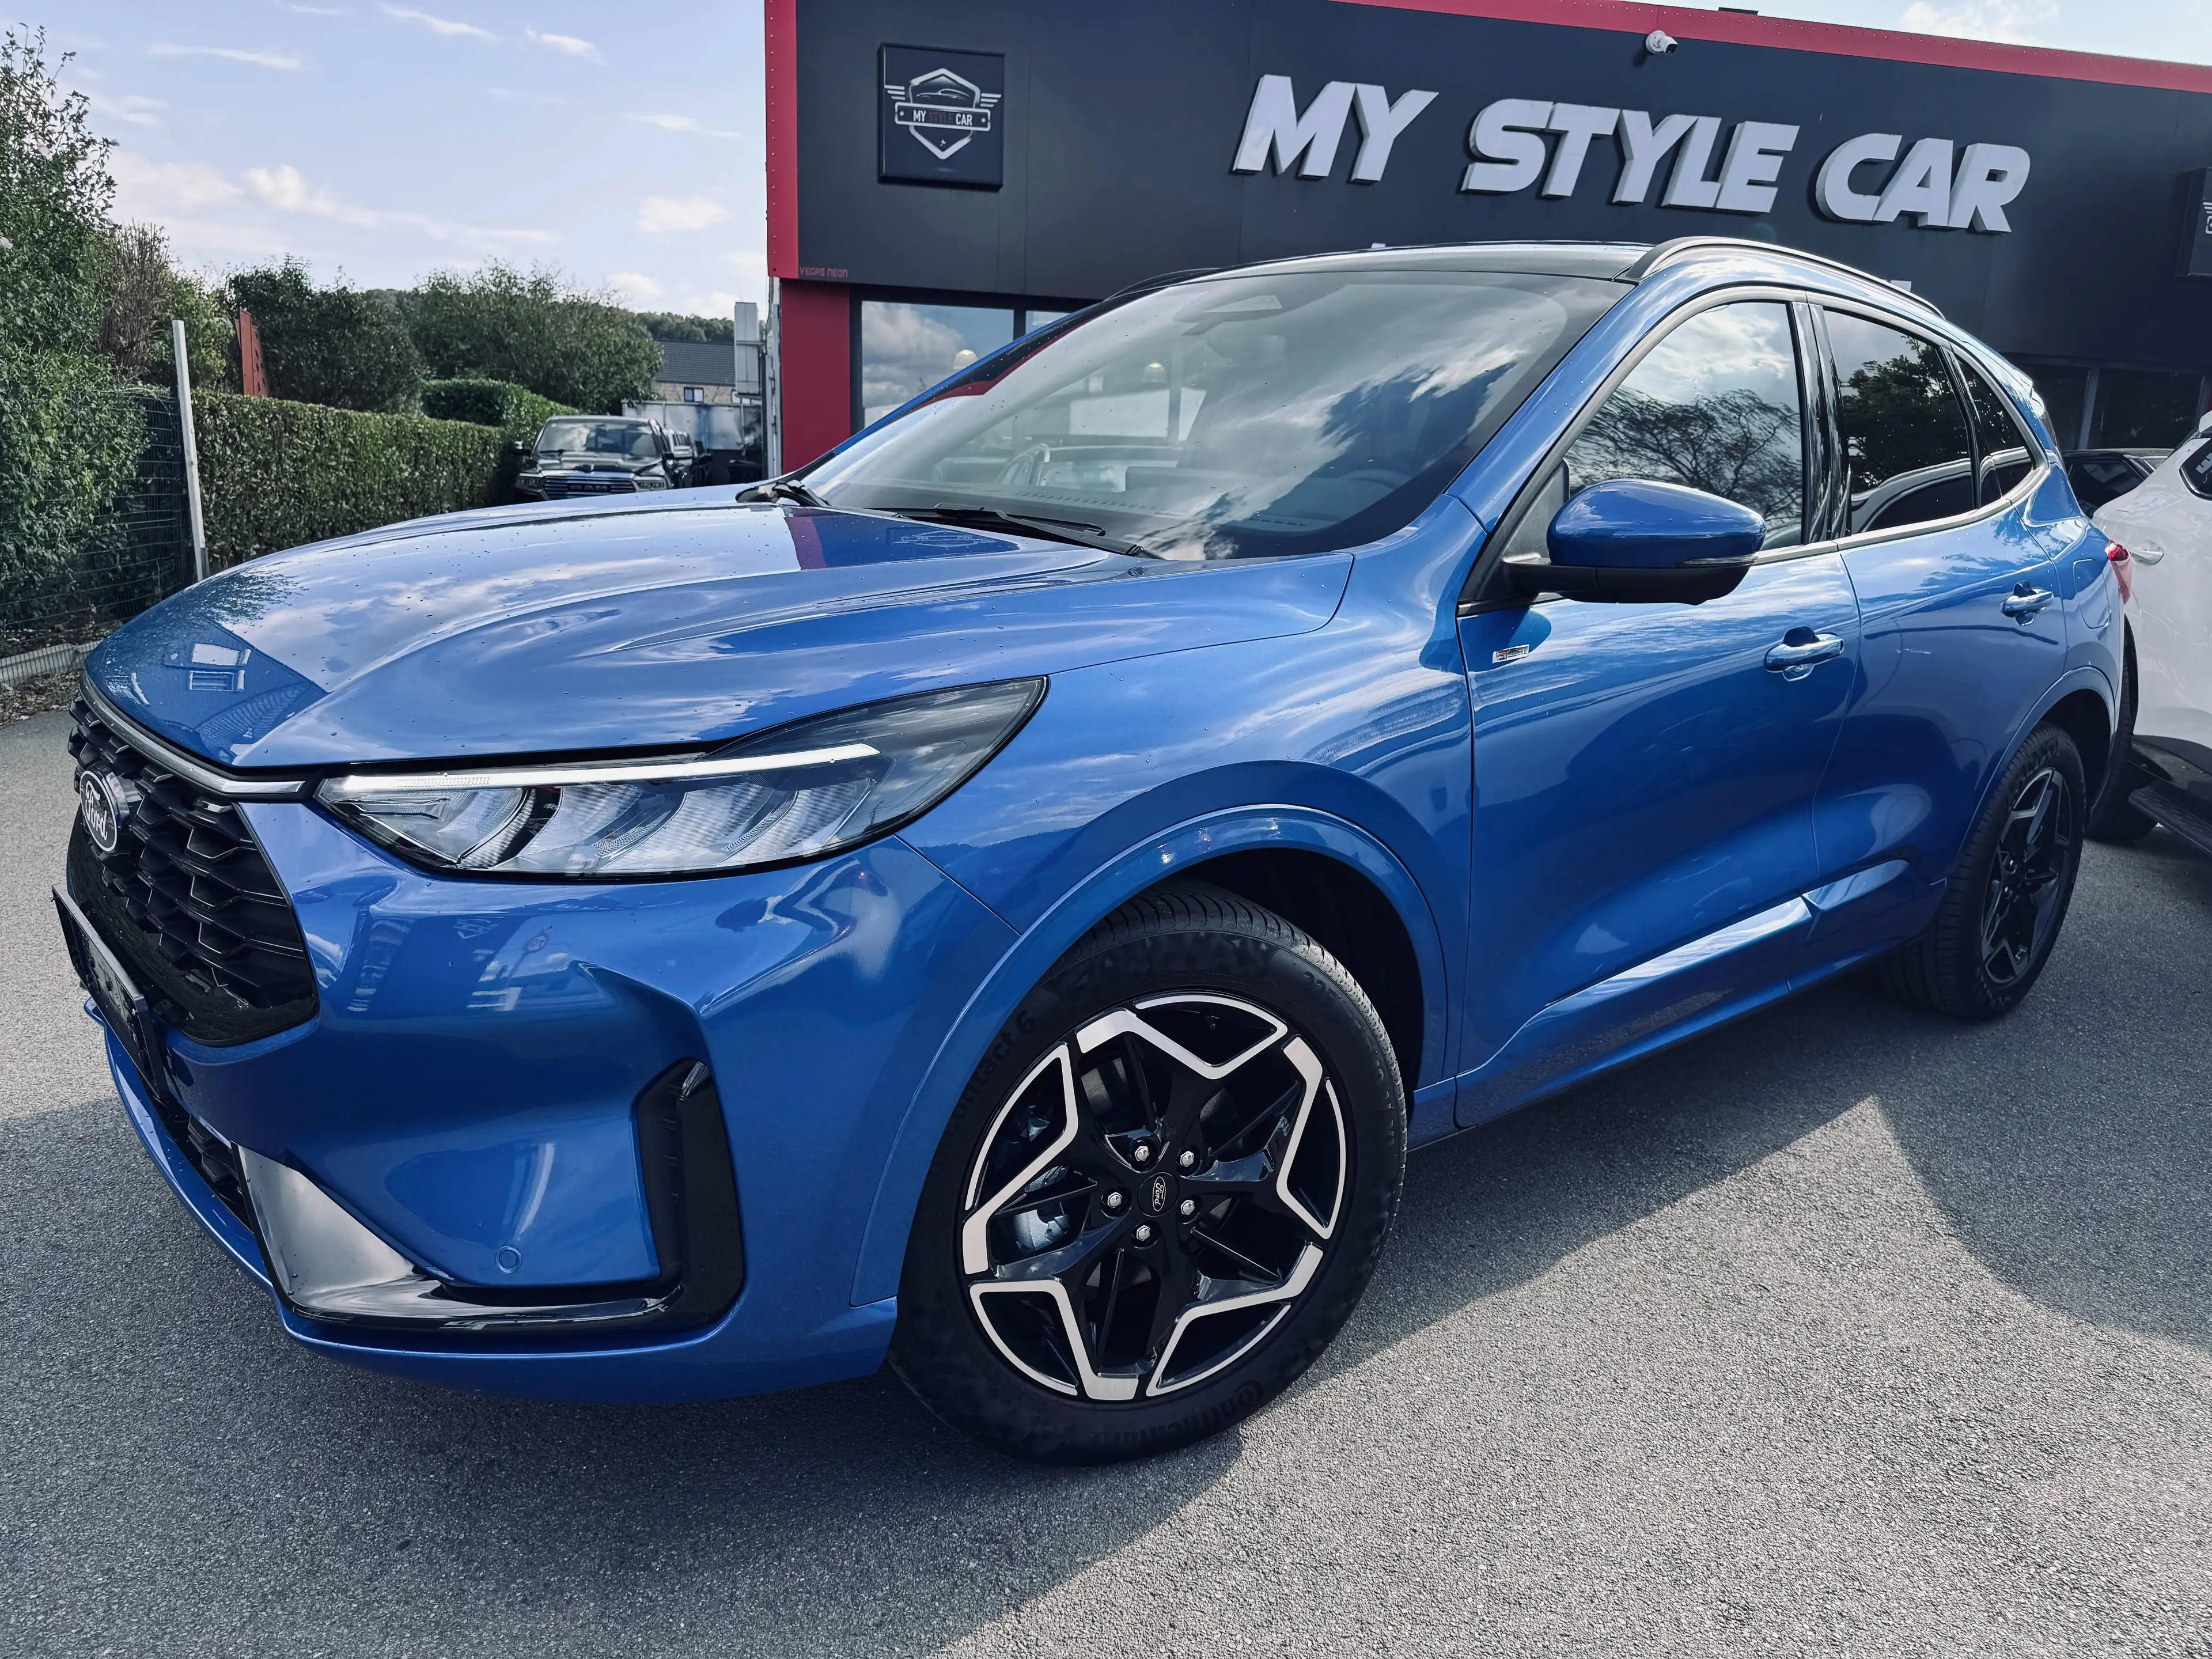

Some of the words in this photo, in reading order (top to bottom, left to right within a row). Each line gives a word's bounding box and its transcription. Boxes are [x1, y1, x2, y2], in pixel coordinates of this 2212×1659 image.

[912, 109, 927, 122] MY
[927, 111, 955, 124] STYLE
[955, 113, 973, 126] CAR
[1232, 74, 1440, 184] MY
[1461, 98, 1801, 214] STYLE
[1815, 132, 2030, 233] CAR
[800, 266, 825, 277] VEGAS
[85, 781, 108, 840] Ford
